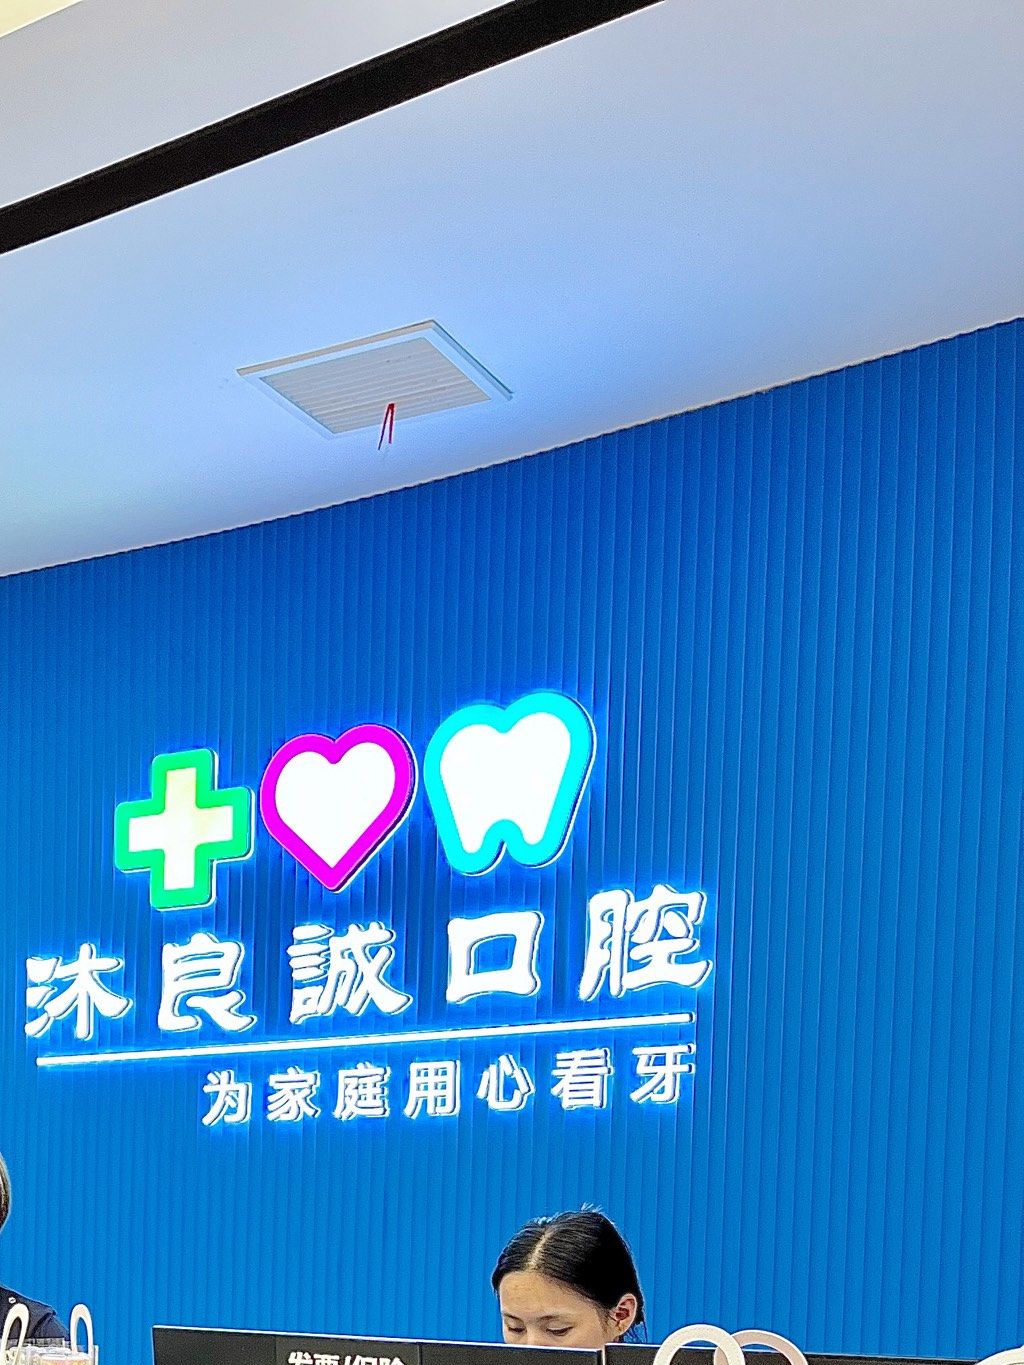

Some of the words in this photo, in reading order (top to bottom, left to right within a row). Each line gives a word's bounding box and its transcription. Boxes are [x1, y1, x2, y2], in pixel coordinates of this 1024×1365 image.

[25, 884, 712, 1041] 沐良誠口腔
[202, 1045, 695, 1126] 为家庭用心看牙
